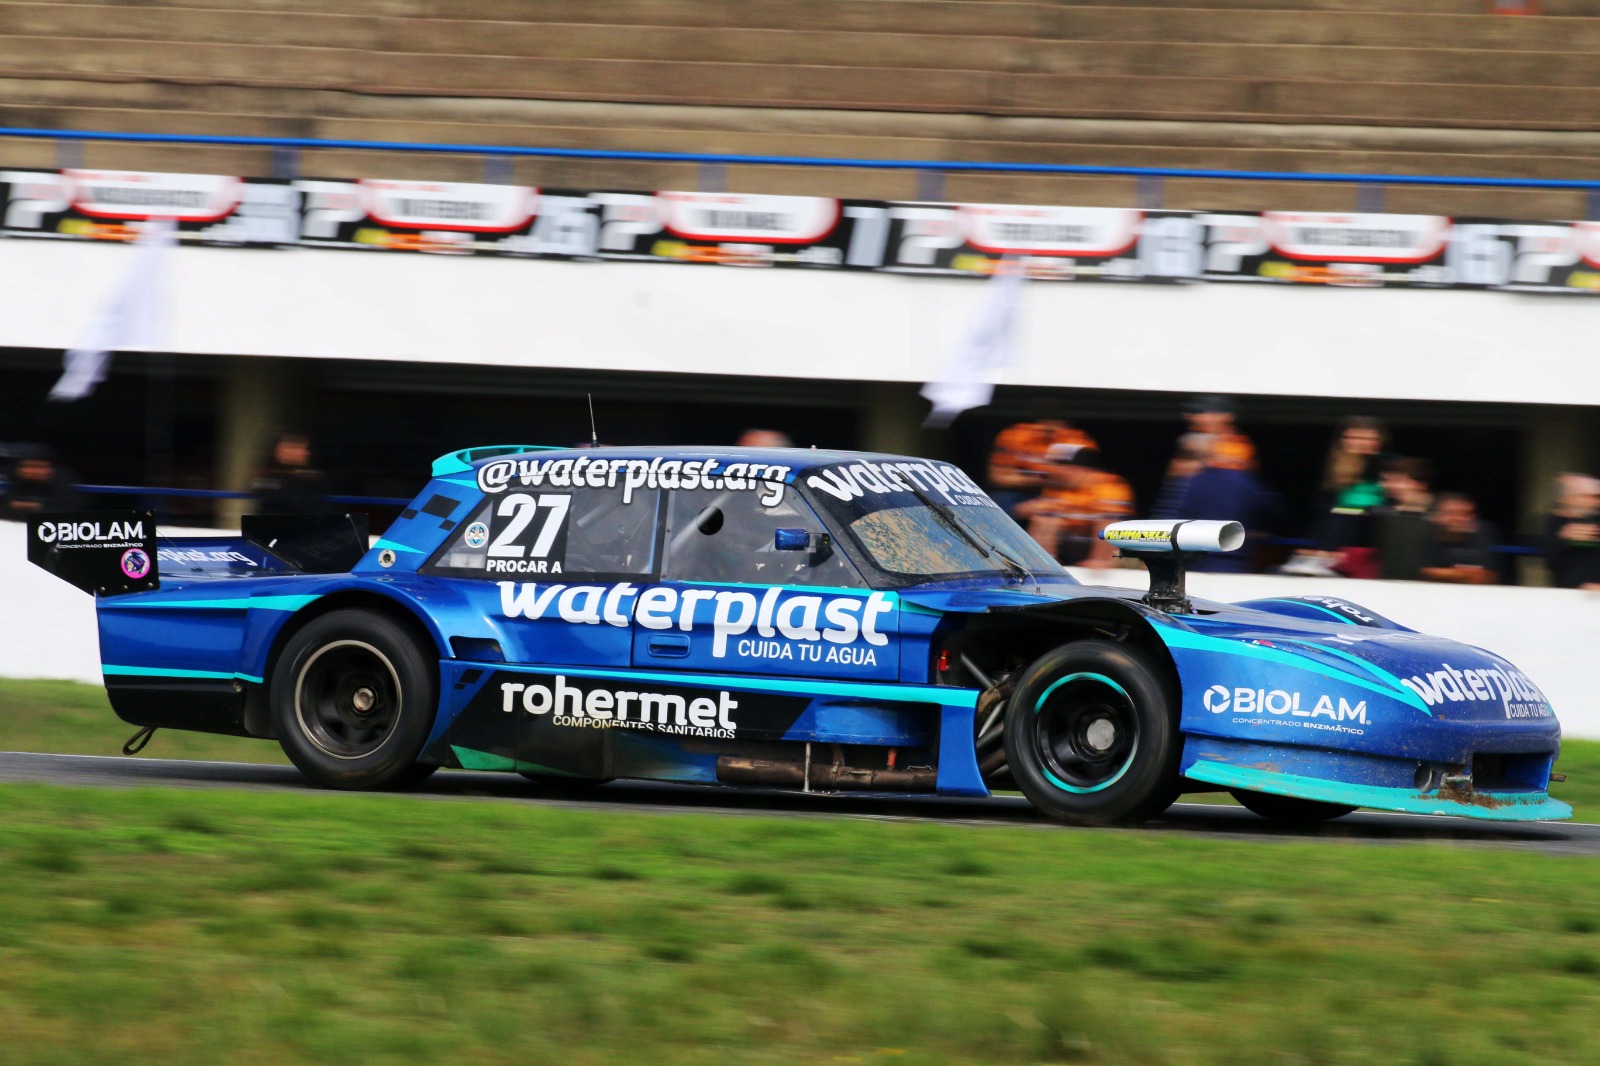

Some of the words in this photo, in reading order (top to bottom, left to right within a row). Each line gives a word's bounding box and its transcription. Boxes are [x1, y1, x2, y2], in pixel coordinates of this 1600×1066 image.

[477, 456, 791, 507] @waterplast.arg
[806, 458, 991, 506] waterplas
[57, 521, 143, 541] BIOLAM
[487, 493, 572, 558] 27
[486, 559, 548, 574] PROCAR
[551, 561, 563, 574] A
[496, 580, 893, 659] waterplast
[738, 639, 793, 660] CUIDA
[798, 644, 822, 662] TU
[825, 646, 877, 667] AGUA
[500, 675, 738, 731] rohermet
[1232, 717, 1301, 727] CONCENTRADO
[1233, 687, 1367, 725] BIOLAM
[552, 715, 654, 731] COMPONENTES
[657, 723, 736, 739] SANITARIOS
